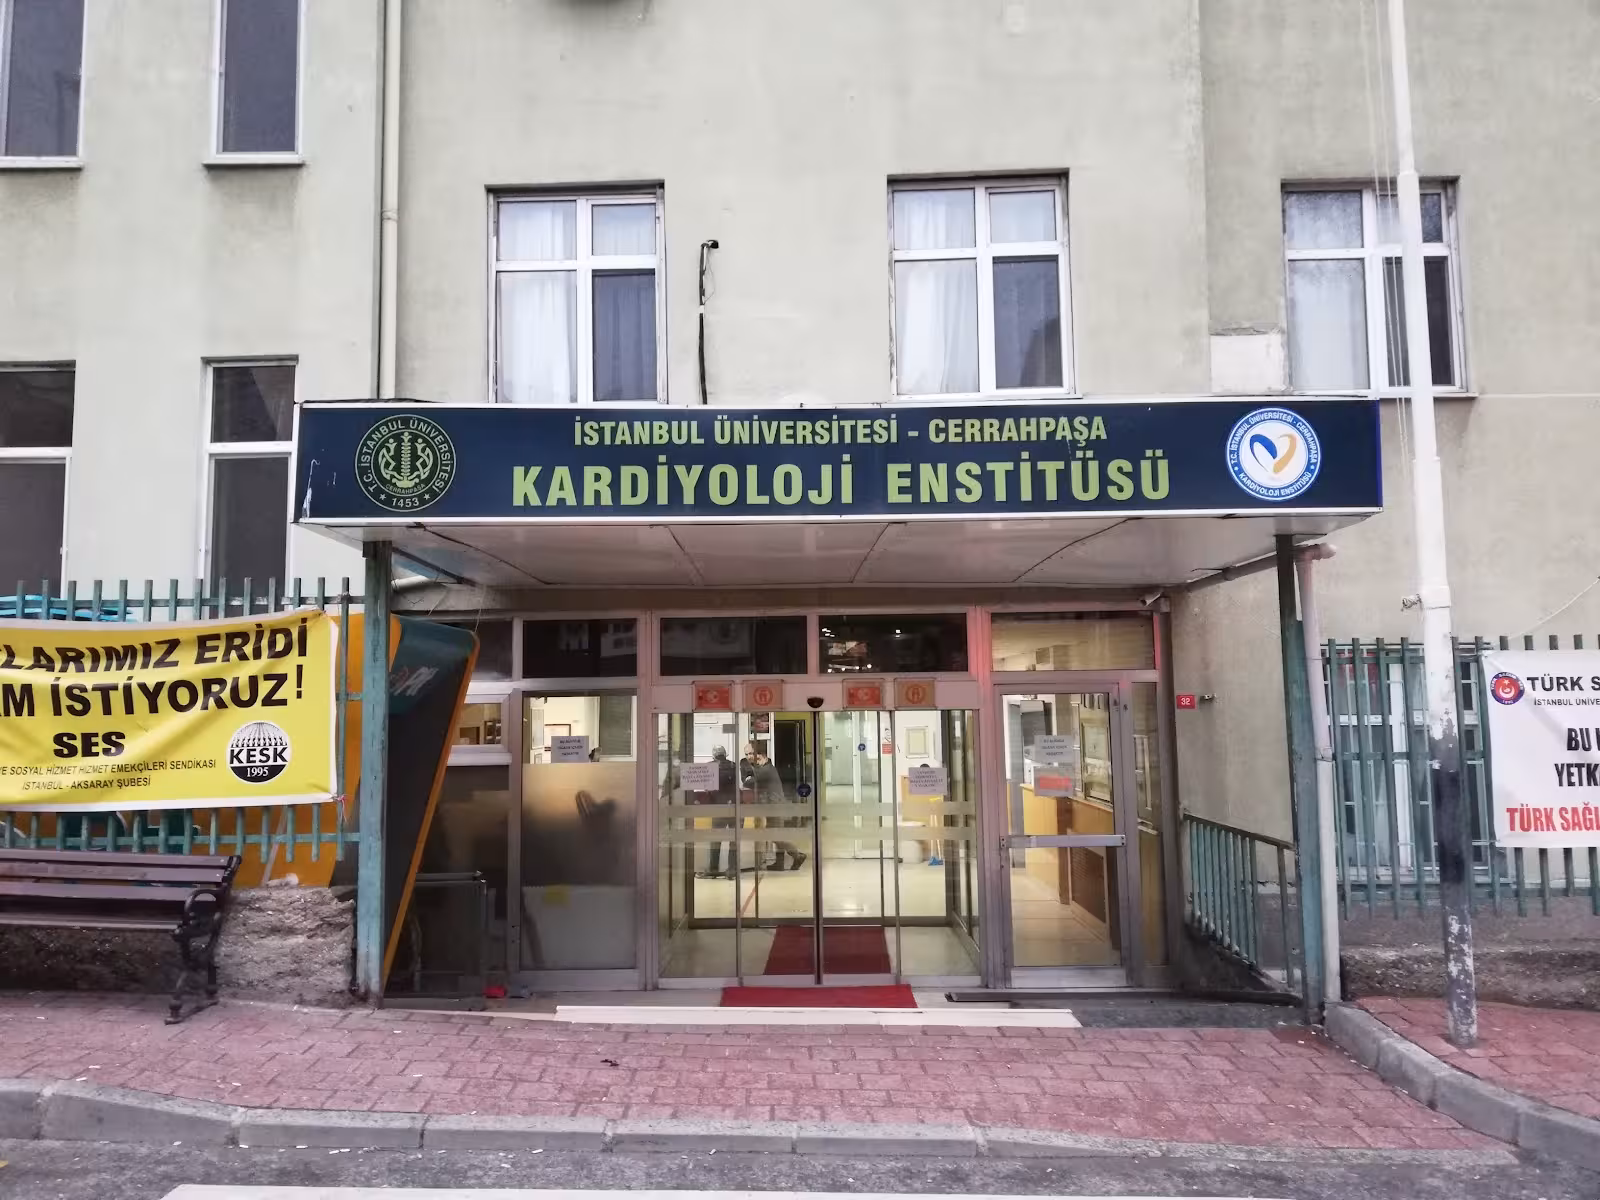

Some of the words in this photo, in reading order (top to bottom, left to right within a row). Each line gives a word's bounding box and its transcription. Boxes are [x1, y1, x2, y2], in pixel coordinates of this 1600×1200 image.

[575, 416, 704, 445] İSTANBUL
[714, 414, 897, 444] ÜNİVERSİTESİ
[928, 416, 1107, 446] CERRAHPAŞA
[358, 420, 405, 467] İSTANBUL
[409, 418, 453, 494] ÜNİVERSİTESİ
[512, 454, 853, 506] KARDİYOLOJİ
[887, 449, 1170, 503] ENSTİTÜSÜ
[392, 497, 420, 508] 1453
[0, 637, 180, 673] LARIMIZ
[194, 618, 308, 665] ERİDİ
[0, 683, 35, 717] M
[51, 664, 304, 718] İSTİYORUZ!
[1527, 674, 1583, 692] TÜRK
[1181, 697, 1191, 706] 32
[1534, 697, 1573, 706] İSTANBUL
[53, 731, 126, 758] SES
[1567, 728, 1592, 751] BU
[229, 746, 288, 765] KESK
[9, 765, 43, 776] SOSYAL
[110, 760, 168, 775] EMEKÇİLERİ
[170, 759, 216, 770] SENDİKASI
[246, 766, 269, 778] 1995
[1554, 763, 1600, 787] YETK
[70, 779, 114, 790] AKSARAY
[117, 775, 151, 790] ŞUBESİ
[1506, 803, 1557, 832] TÜRK
